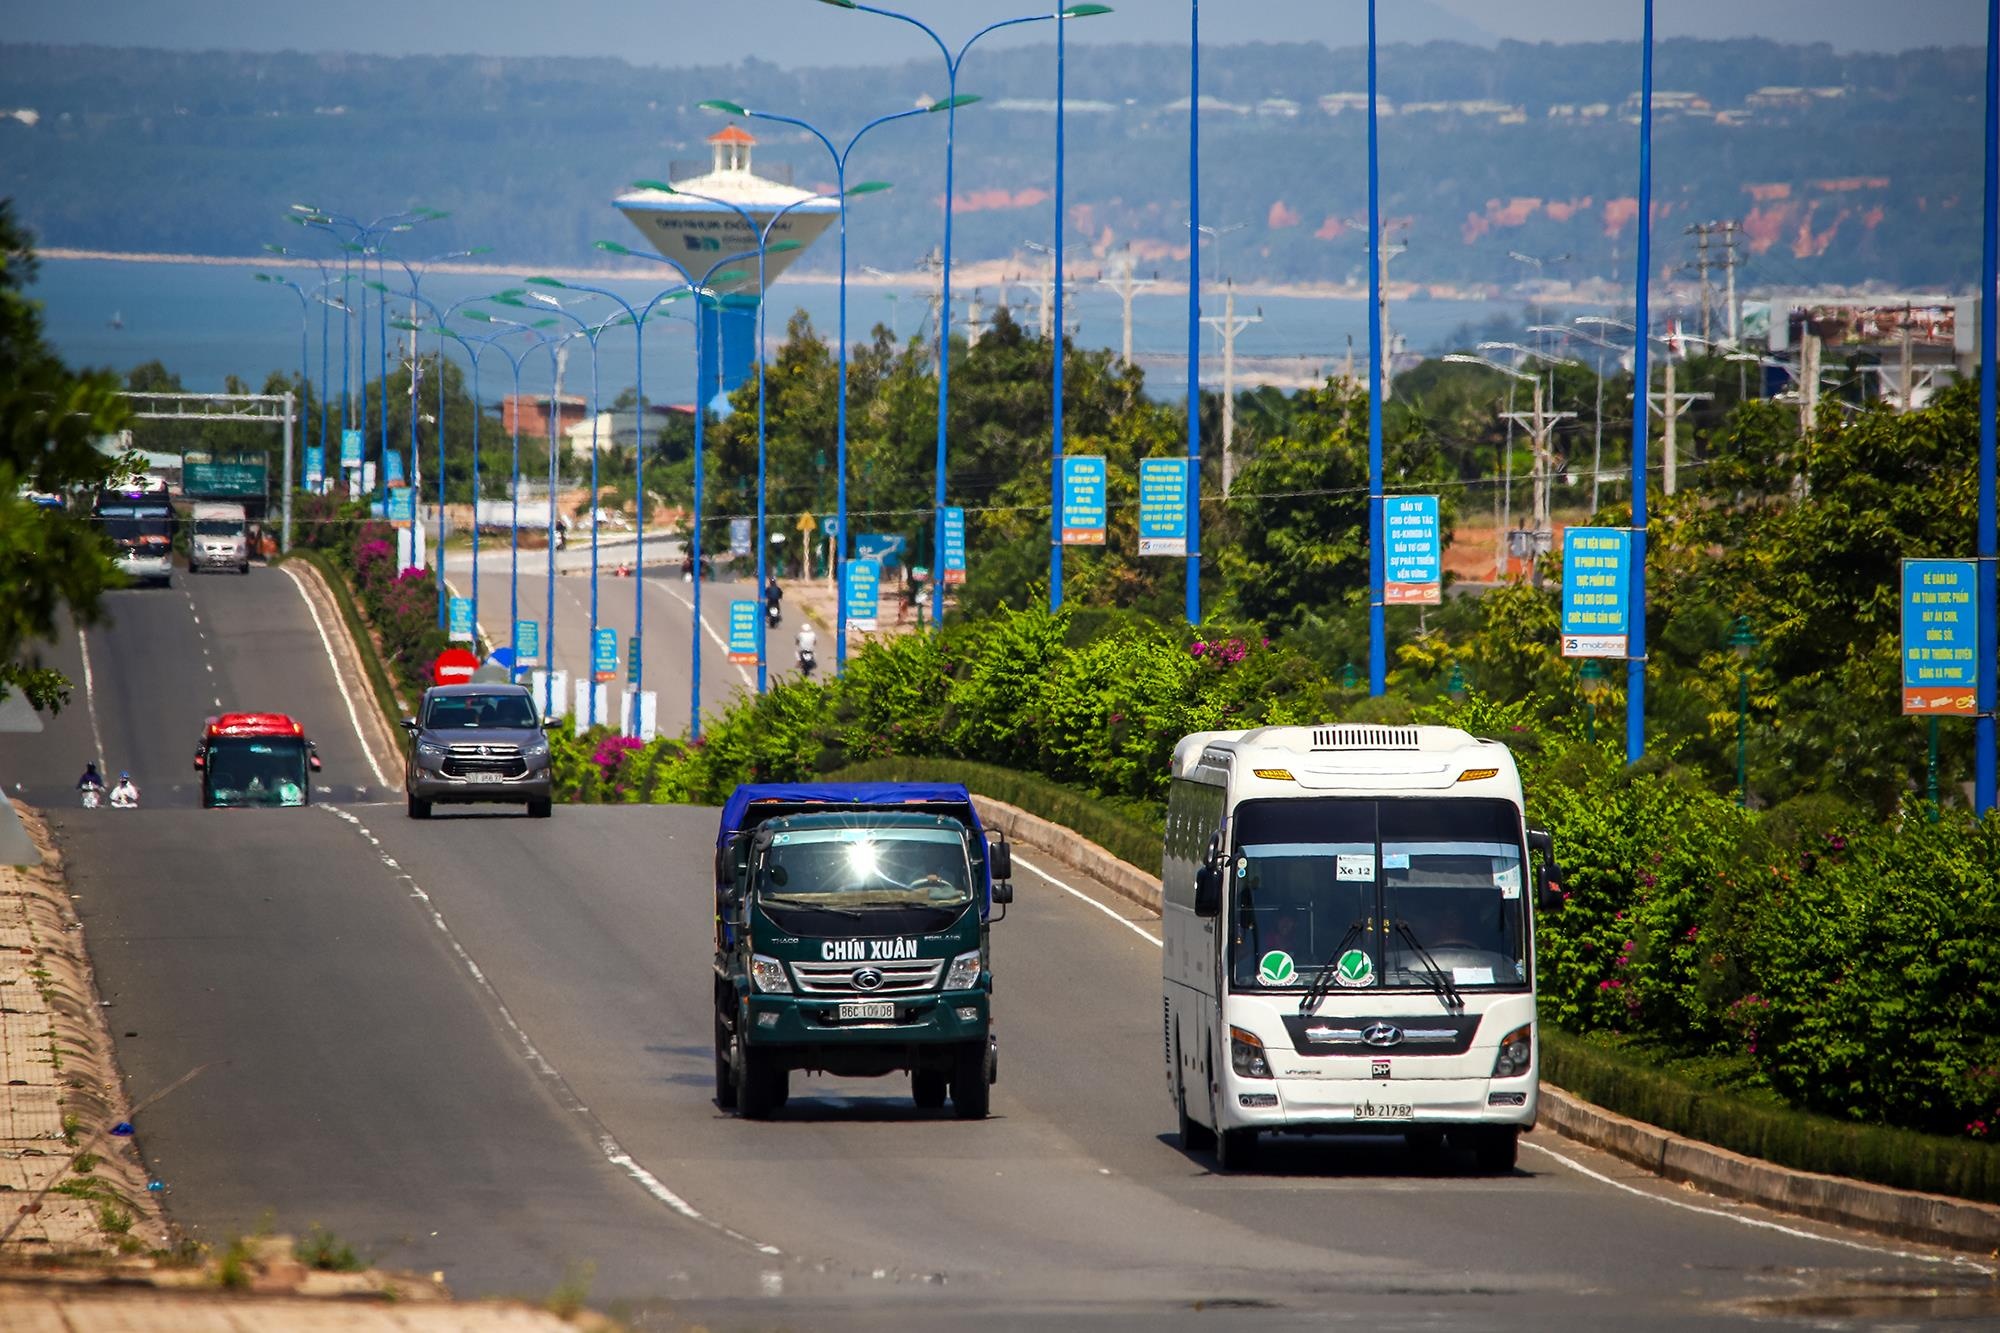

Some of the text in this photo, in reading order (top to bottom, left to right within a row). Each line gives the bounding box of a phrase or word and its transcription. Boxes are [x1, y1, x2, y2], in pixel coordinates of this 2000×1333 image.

[822, 937, 918, 960] CHÍN XUÂN
[842, 1006, 859, 1017] 86C
